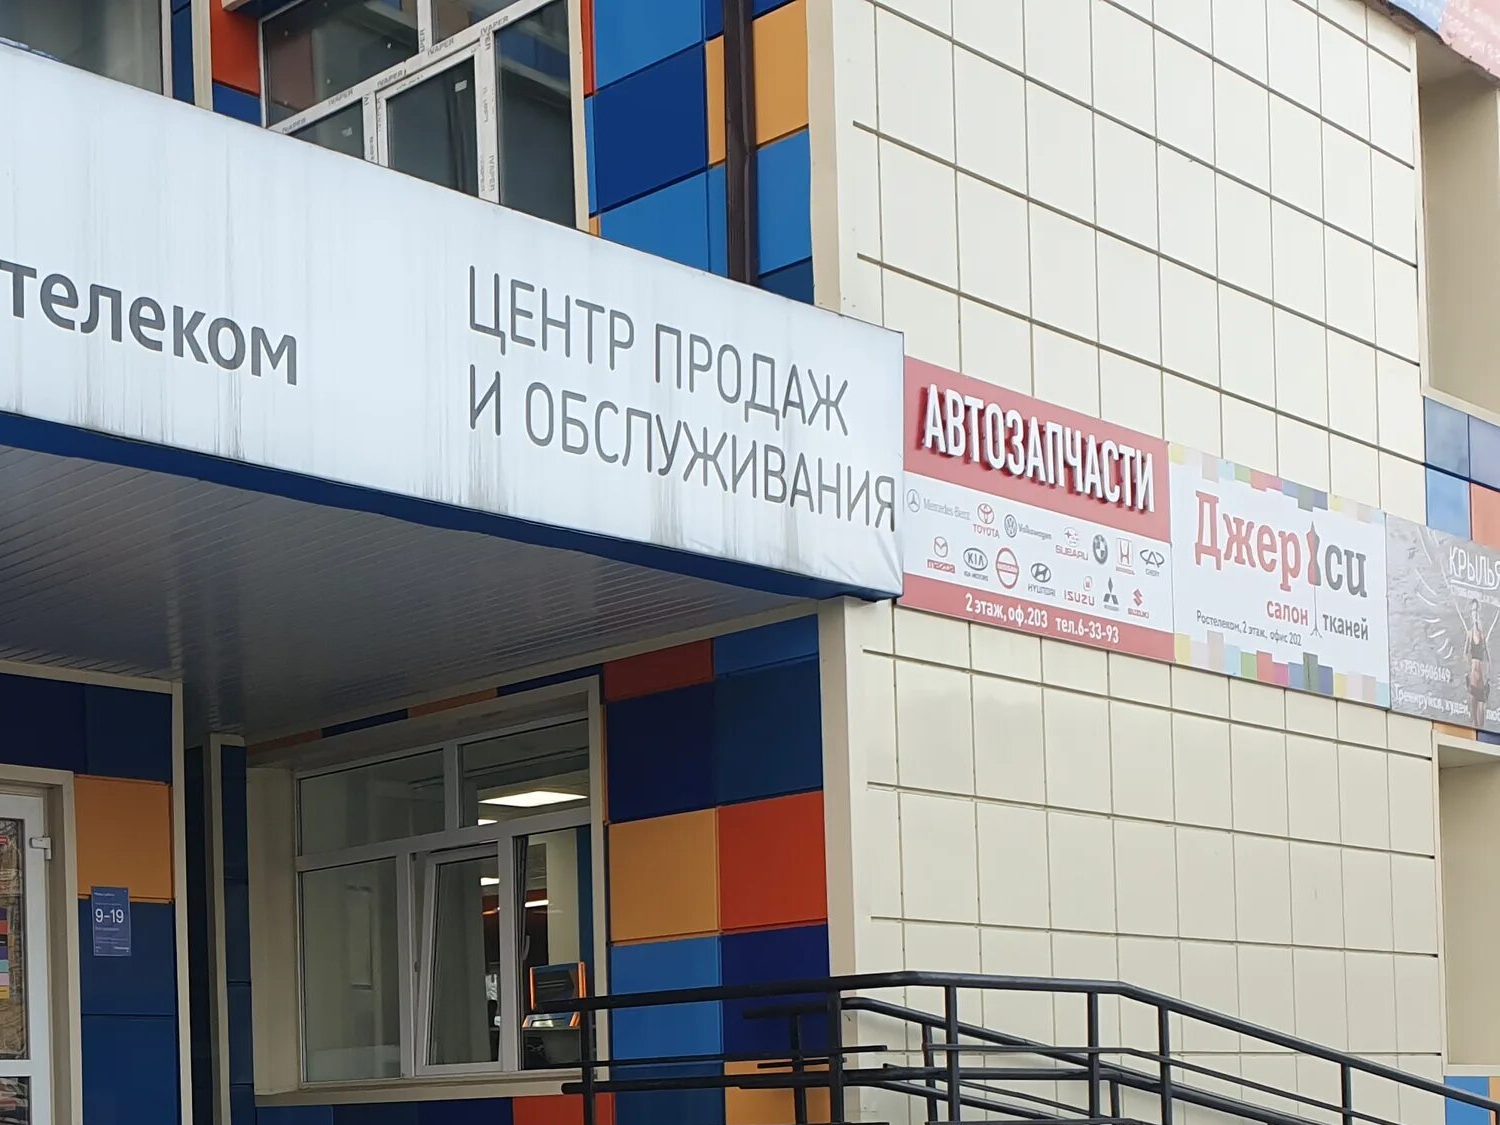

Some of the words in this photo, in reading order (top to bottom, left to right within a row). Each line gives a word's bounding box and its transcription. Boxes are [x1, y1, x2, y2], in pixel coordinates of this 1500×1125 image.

[469, 265, 635, 370] ЦЕНТР
[655, 323, 848, 436] ПРОДАЖ
[470, 364, 500, 436] И
[525, 382, 895, 532] ОБСЛУЖИВАНИЯ
[923, 384, 1155, 512] АВТОЗАПЧАСТИ
[973, 523, 1000, 539] TOYOTA
[1055, 544, 1089, 561] SUBARU
[965, 593, 973, 612] 2
[974, 599, 1007, 622] этаж,
[1008, 604, 1048, 628] оф.203
[1064, 589, 1095, 606] ISUZU
[1266, 600, 1309, 626] салон
[1322, 614, 1369, 641] тканей
[1269, 629, 1288, 643] офис
[1289, 632, 1302, 646] 202
[95, 908, 124, 924] 9-19
